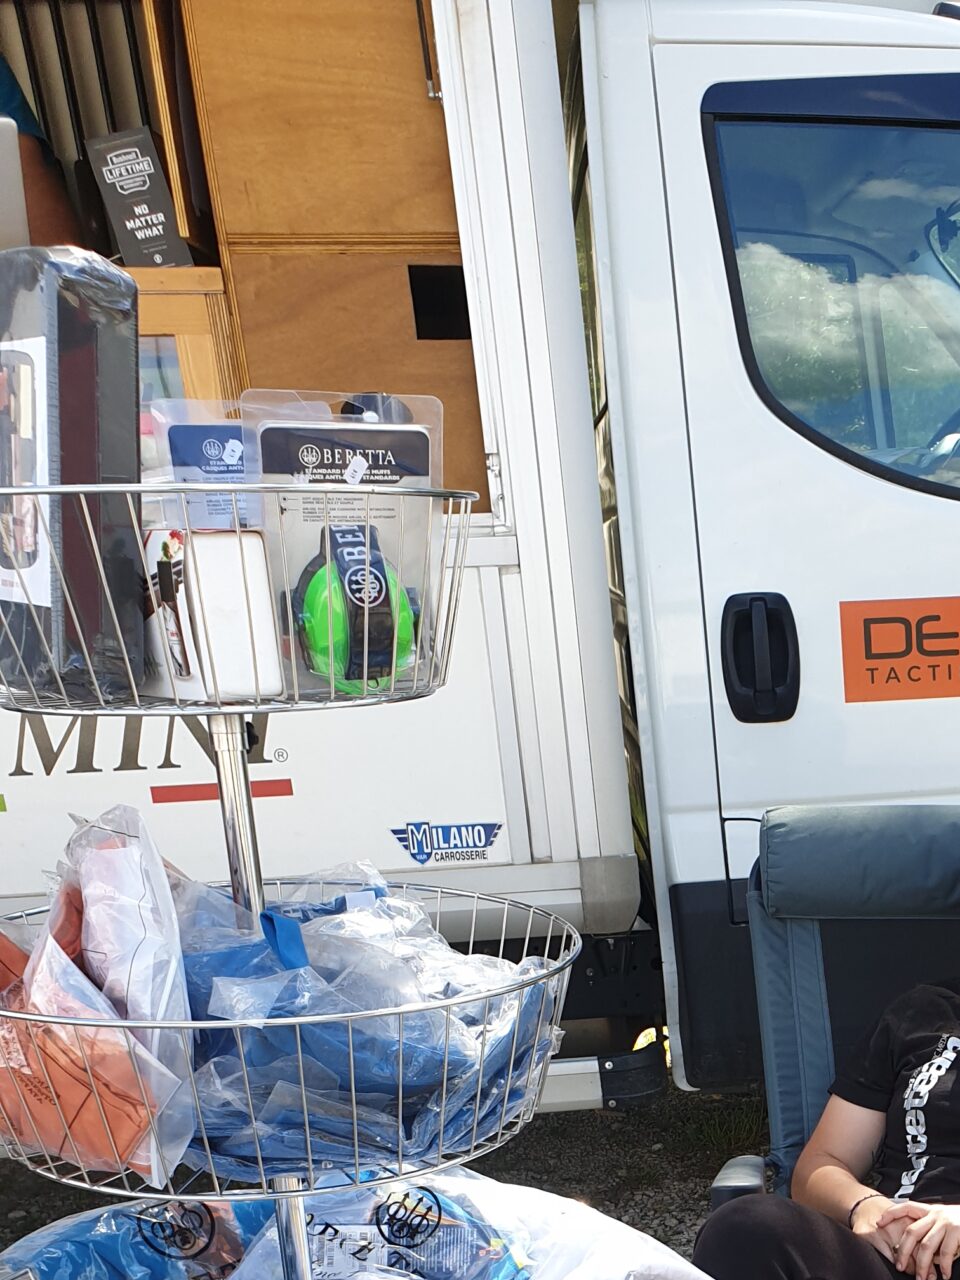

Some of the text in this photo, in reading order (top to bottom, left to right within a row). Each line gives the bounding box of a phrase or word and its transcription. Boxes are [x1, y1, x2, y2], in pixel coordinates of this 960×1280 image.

[105, 161, 151, 179] LIFETIME
[133, 204, 149, 216] NO
[125, 213, 165, 230] MATTER
[134, 225, 164, 240] WHAT
[408, 824, 486, 853] MILANO
[434, 850, 487, 862] CARROSSERIE
